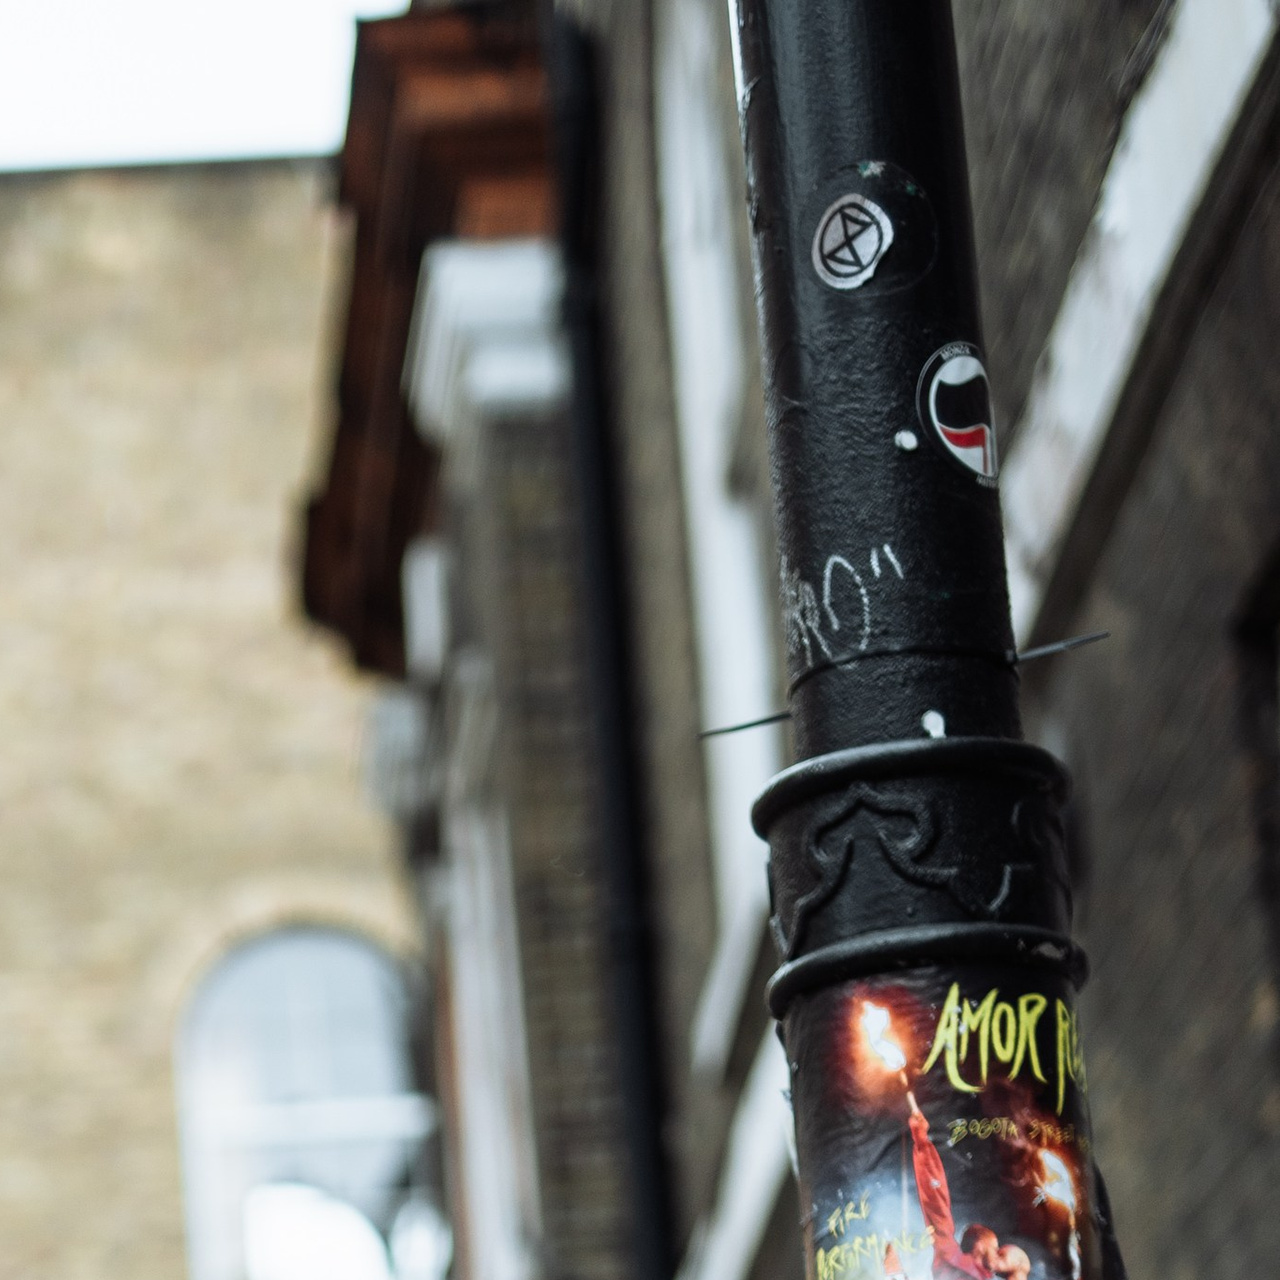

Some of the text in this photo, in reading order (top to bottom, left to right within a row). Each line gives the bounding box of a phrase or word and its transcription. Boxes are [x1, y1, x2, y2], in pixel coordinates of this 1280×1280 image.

[921, 982, 1048, 1092] AMOR
[947, 1117, 1018, 1147] BOGOTA
[827, 1188, 870, 1239] FIRE
